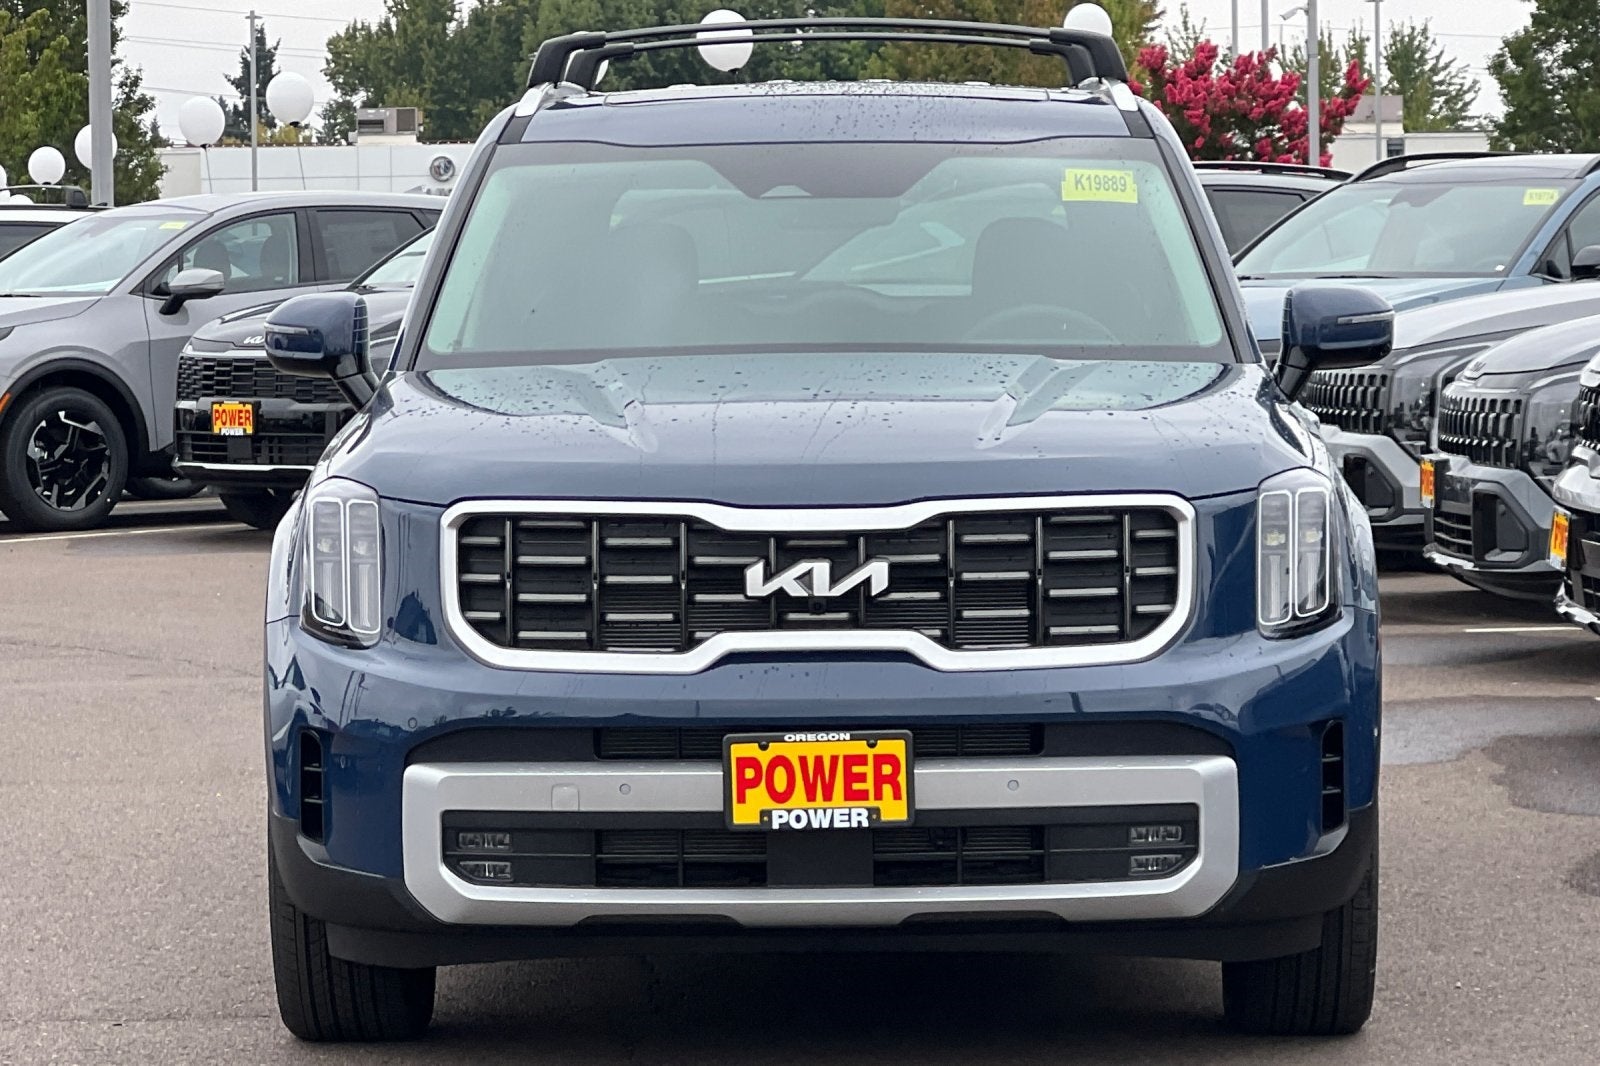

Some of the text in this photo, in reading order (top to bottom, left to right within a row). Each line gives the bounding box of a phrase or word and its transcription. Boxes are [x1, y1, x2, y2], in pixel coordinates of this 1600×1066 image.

[1074, 173, 1127, 193] K19889
[214, 408, 252, 427] POWER
[220, 427, 244, 436] POWER
[745, 558, 889, 597] KIA
[783, 732, 851, 742] OREGON
[735, 753, 903, 805] POWER
[771, 807, 870, 830] POWER
